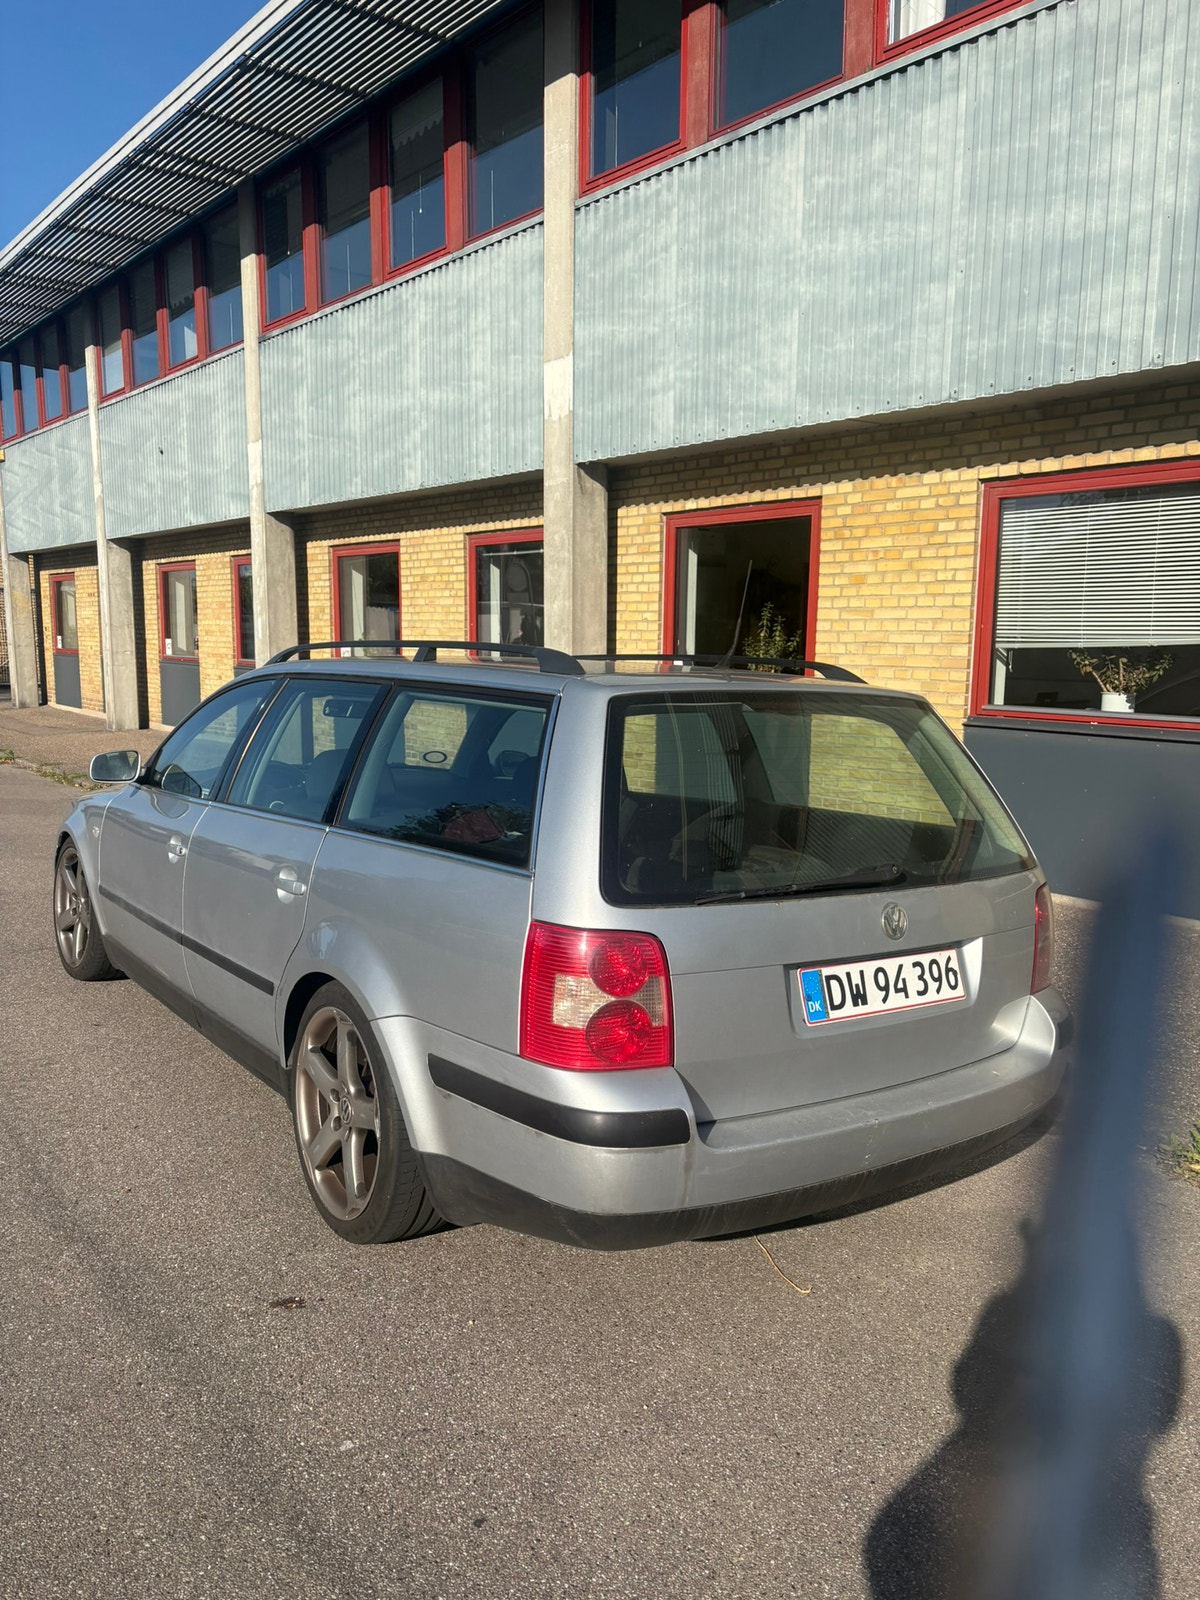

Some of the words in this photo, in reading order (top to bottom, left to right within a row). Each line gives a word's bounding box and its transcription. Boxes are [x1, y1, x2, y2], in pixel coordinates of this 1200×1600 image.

[824, 969, 869, 1012] DW
[873, 963, 910, 1005] 94
[912, 955, 959, 997] 396
[808, 1000, 822, 1013] DK
